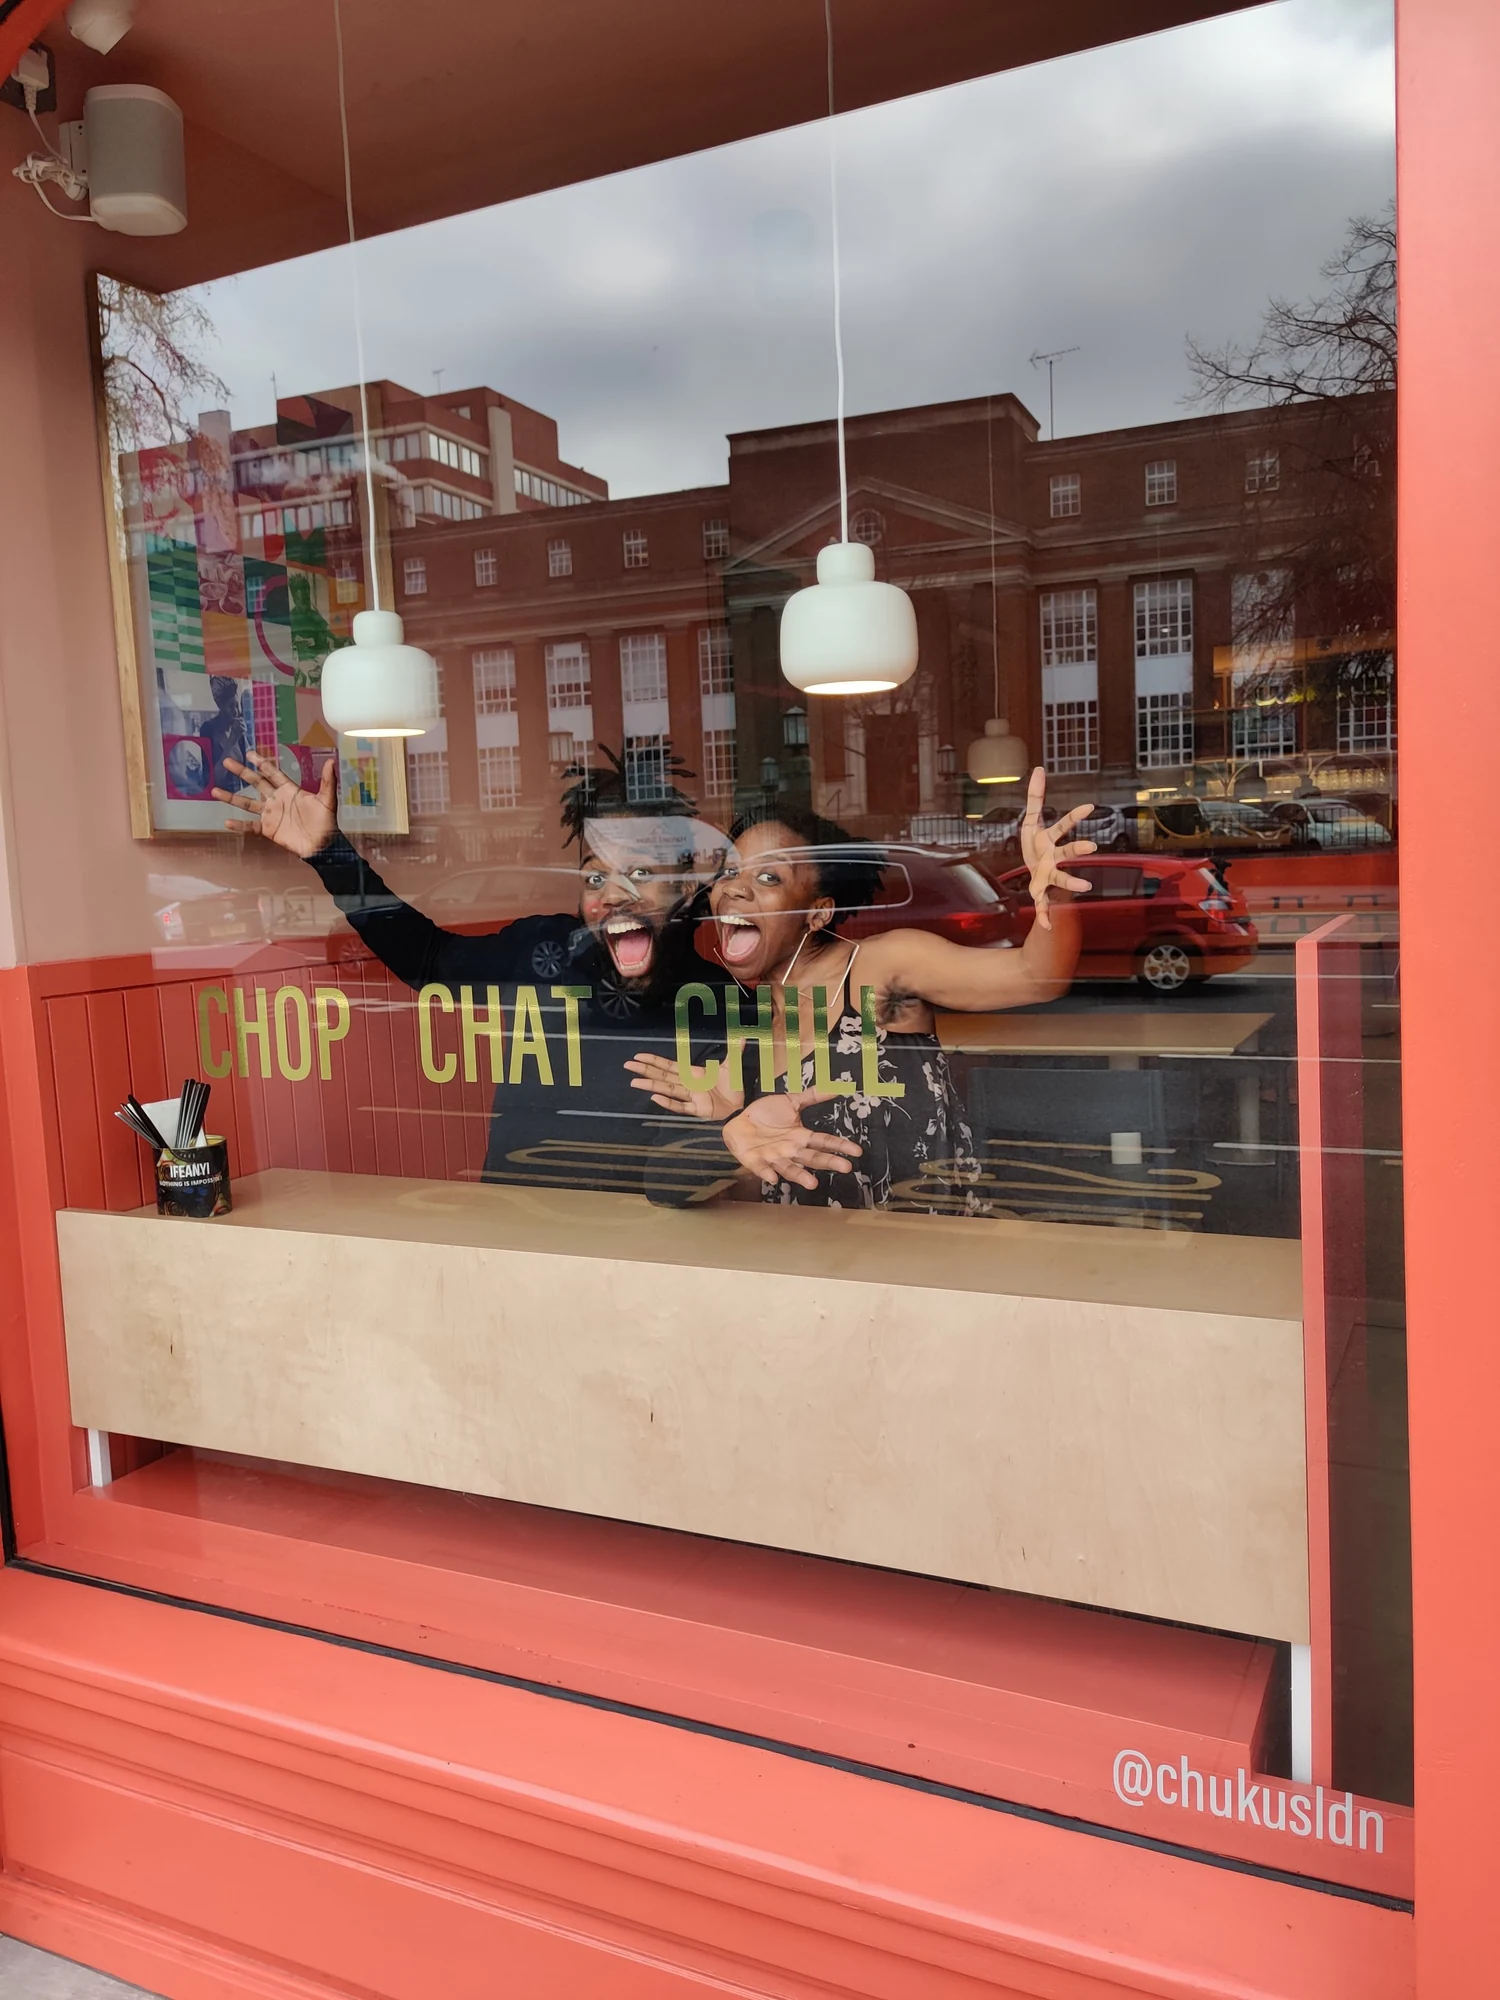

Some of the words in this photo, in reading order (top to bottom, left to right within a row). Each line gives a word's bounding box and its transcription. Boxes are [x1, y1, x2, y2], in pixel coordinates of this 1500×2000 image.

[199, 984, 351, 1081] CHOP
[418, 983, 592, 1086] CHAT
[674, 982, 906, 1097] CHILL
[169, 1162, 210, 1178] IFEANYI
[1113, 1749, 1384, 1854] @chukusldn
